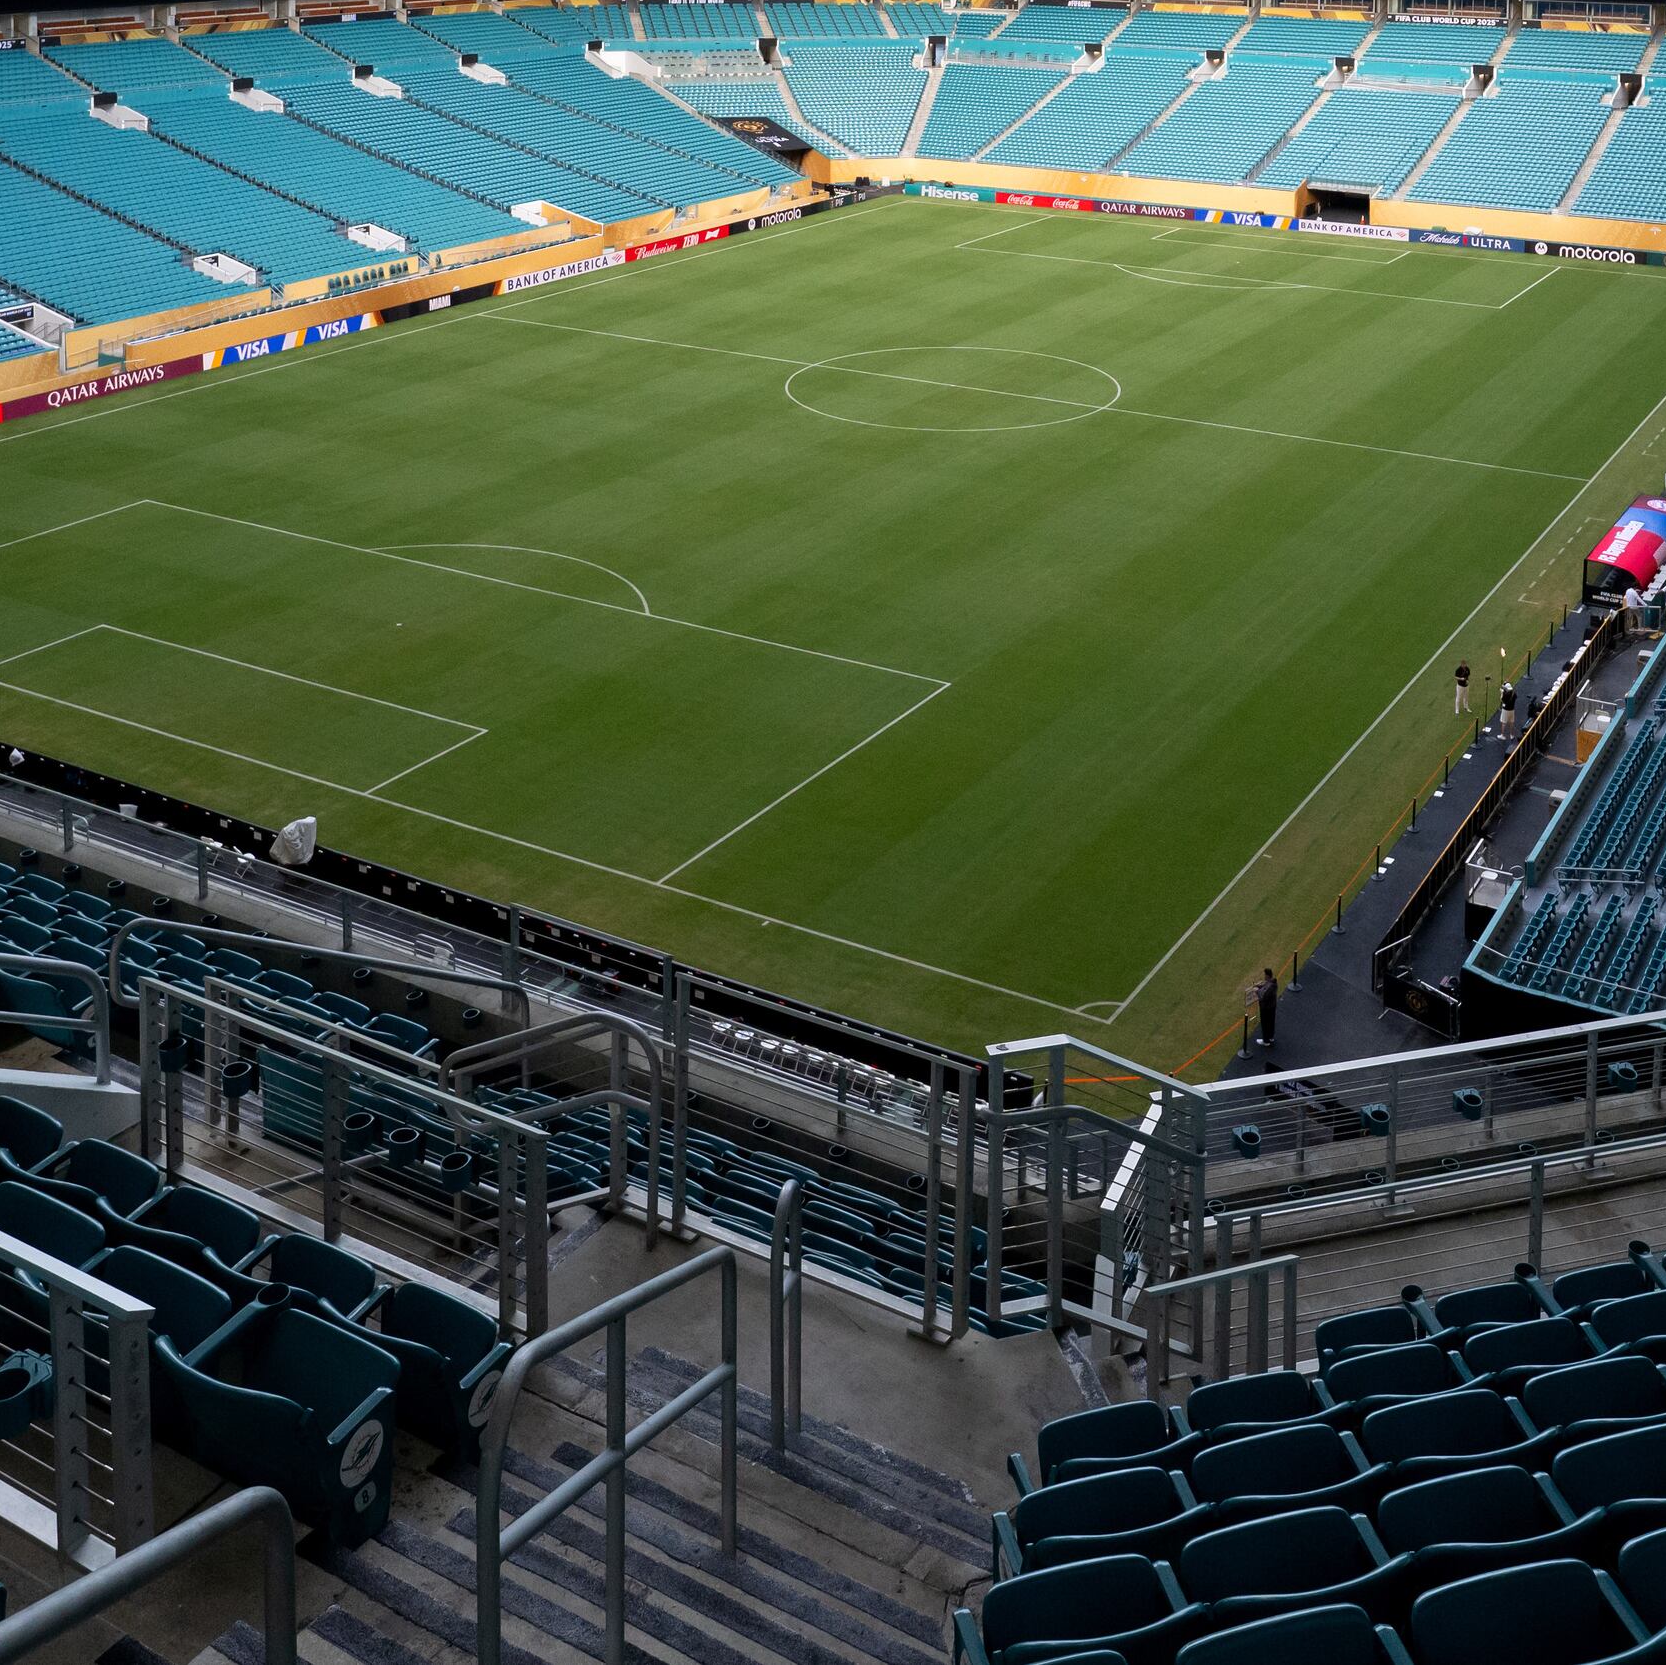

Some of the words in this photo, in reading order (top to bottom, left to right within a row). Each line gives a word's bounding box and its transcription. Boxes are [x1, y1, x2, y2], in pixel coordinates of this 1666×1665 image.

[1395, 15, 1411, 23] FIFA
[835, 197, 844, 207] PIF
[921, 184, 979, 202] Hisense
[1007, 194, 1034, 206] Coca-Cola
[1052, 198, 1080, 210] Coca-Cola
[1101, 202, 1137, 214] QATAR
[1140, 206, 1186, 218] AIRWAYS
[761, 208, 802, 228] motorola
[1231, 212, 1262, 227] VISA
[1300, 222, 1328, 232] BANK
[1330, 225, 1344, 233] OF
[1345, 227, 1393, 238] AMERICA
[635, 243, 678, 261] Budweiser
[682, 234, 700, 249] ZERO
[1420, 232, 1460, 245] Michelob
[1471, 237, 1511, 250] ULTRA
[1559, 244, 1636, 264] motorola
[507, 270, 540, 291] BANK
[542, 268, 556, 283] OF
[560, 256, 609, 278] AMERICA
[429, 294, 451, 312] MIAMI
[316, 319, 349, 341] VISA
[235, 339, 270, 361] VISA
[47, 381, 99, 407] QATAR
[104, 365, 165, 392] AIRWAYS
